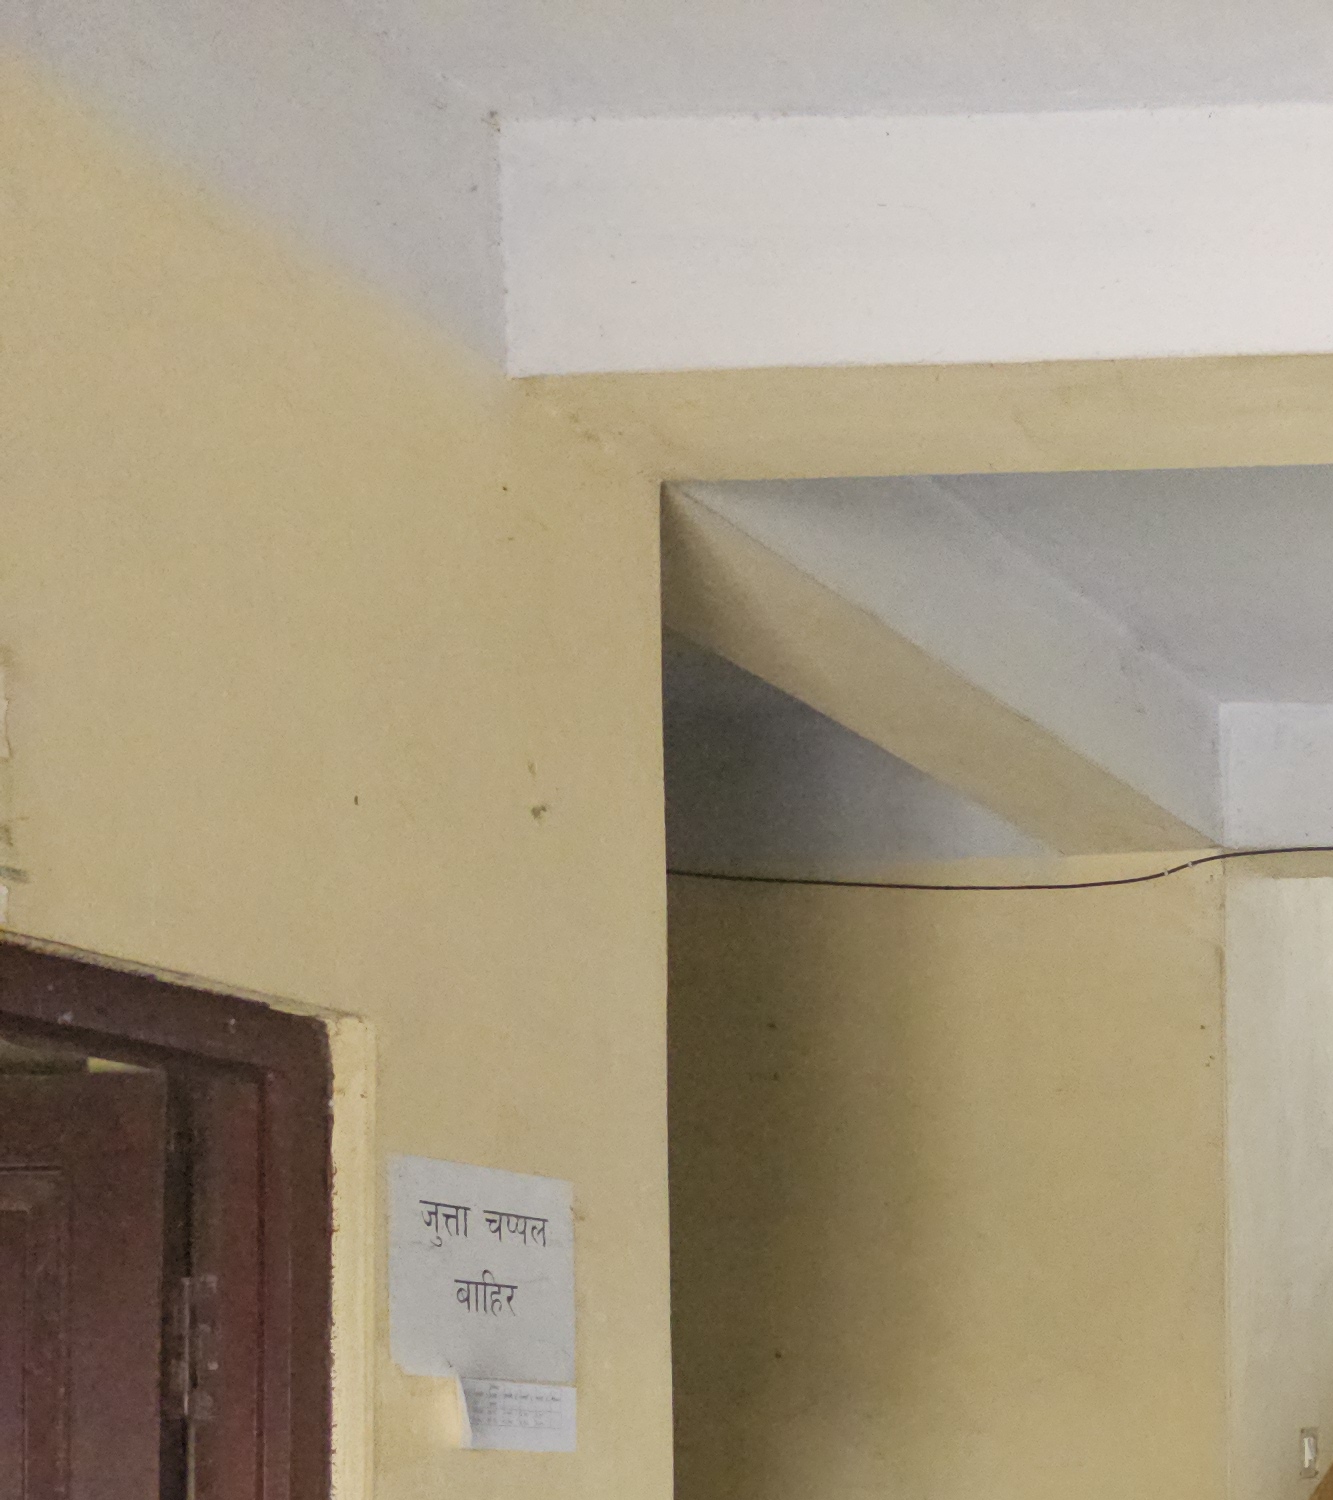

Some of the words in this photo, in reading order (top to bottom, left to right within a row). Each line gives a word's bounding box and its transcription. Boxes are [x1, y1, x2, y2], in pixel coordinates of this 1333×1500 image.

[419, 1199, 471, 1248] जुत्ता
[483, 1209, 549, 1248] चप्पल
[453, 1269, 518, 1317] बाहिर
